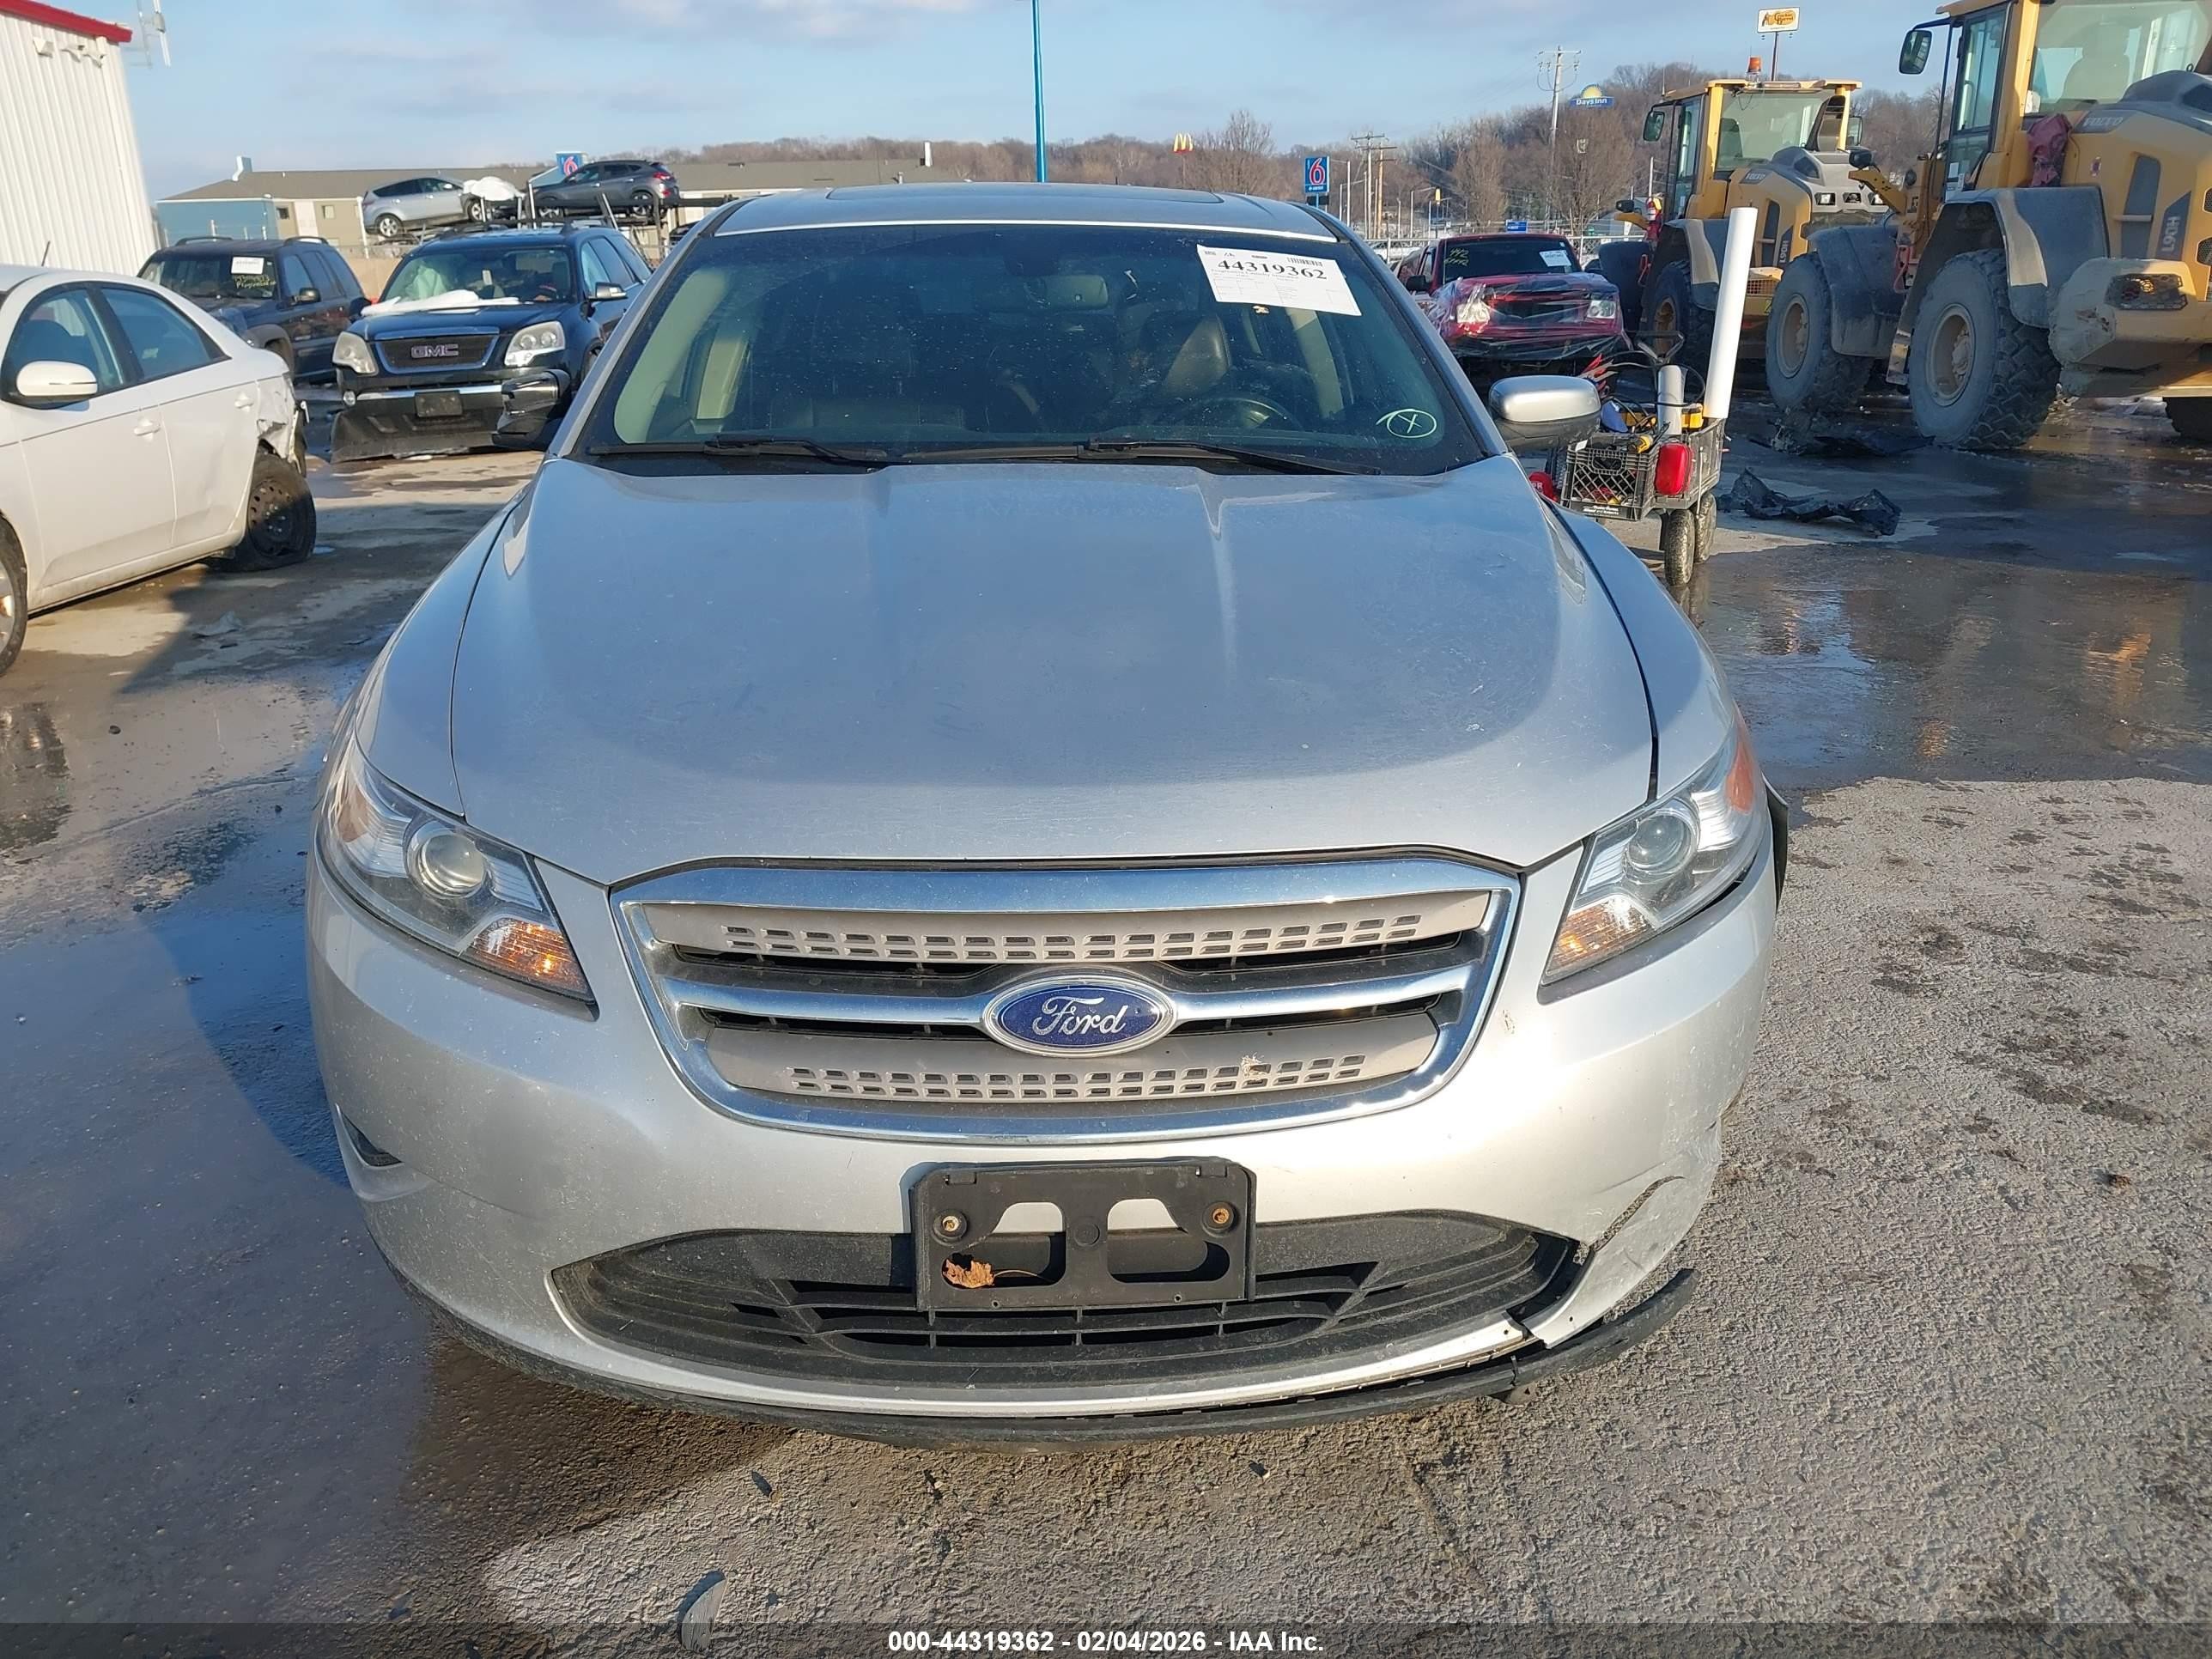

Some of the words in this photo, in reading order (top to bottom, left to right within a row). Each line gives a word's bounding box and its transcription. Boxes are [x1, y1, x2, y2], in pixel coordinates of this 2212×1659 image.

[1310, 157, 1325, 185] 6
[2160, 216, 2181, 252] L90H
[1779, 240, 1790, 264] L90H
[1218, 259, 1328, 280] 44319362
[411, 343, 459, 358] GMC
[1032, 995, 1129, 1036] Ford
